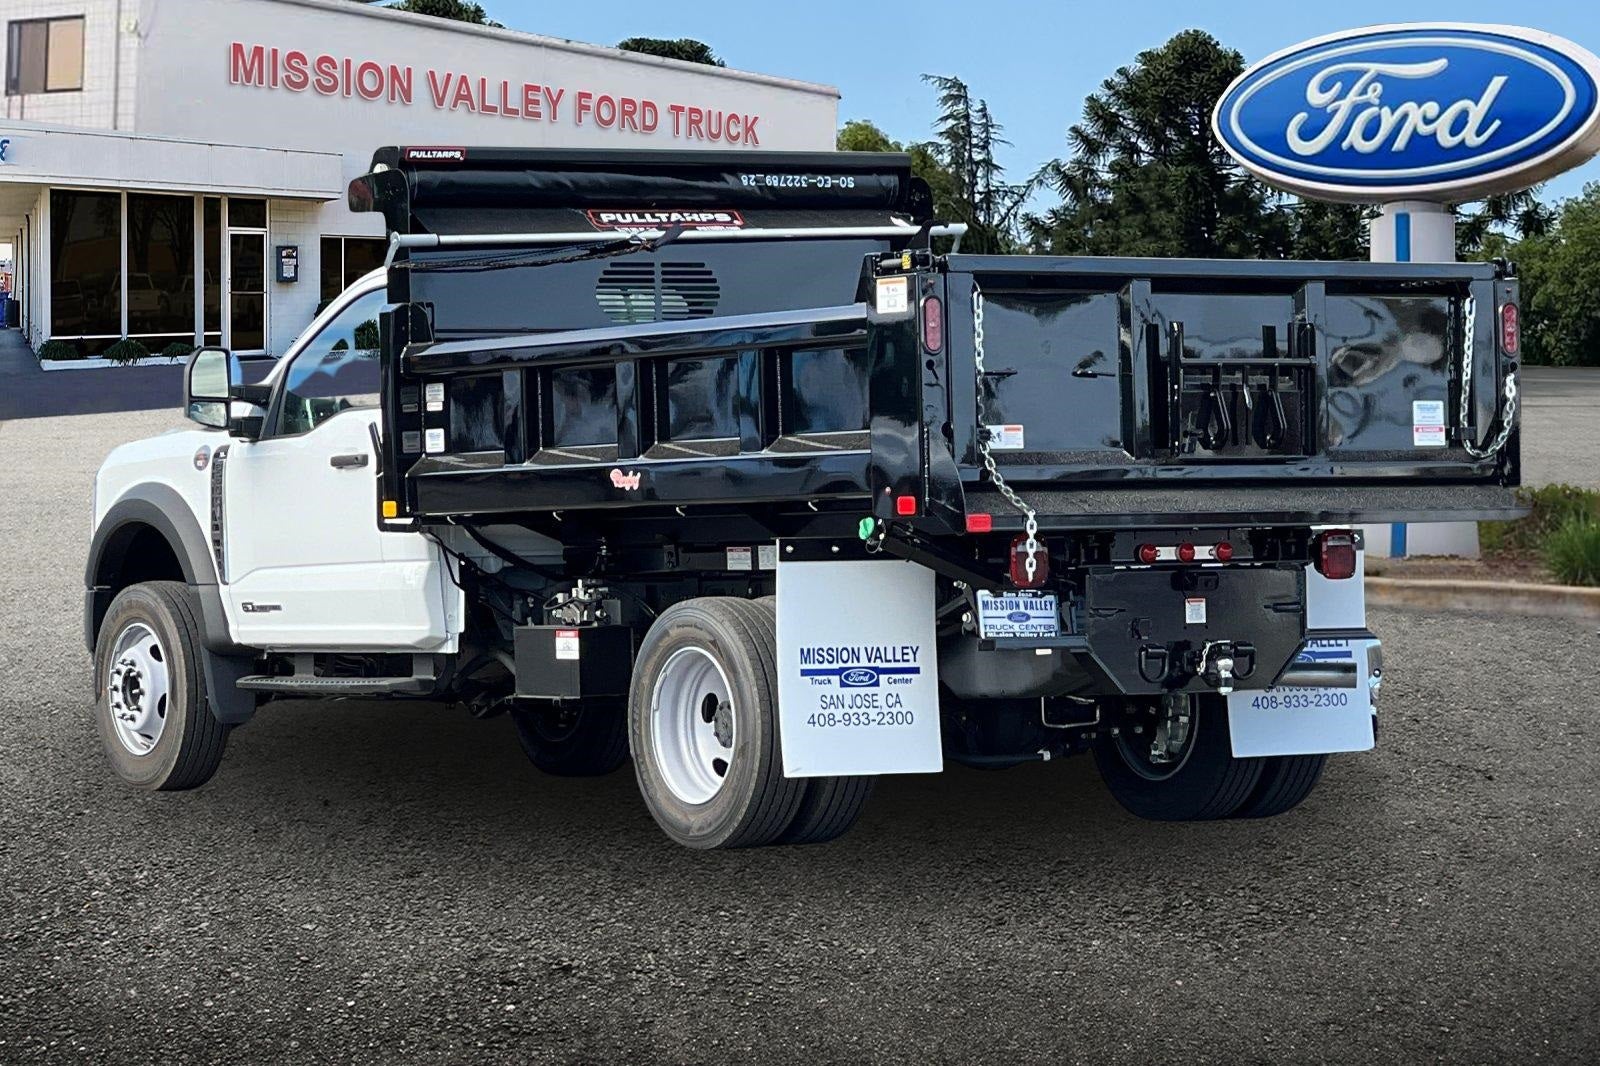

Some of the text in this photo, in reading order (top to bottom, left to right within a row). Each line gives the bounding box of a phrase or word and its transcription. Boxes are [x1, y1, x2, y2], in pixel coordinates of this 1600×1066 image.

[229, 41, 761, 146] MISSION VALLEY FORD TRUCK
[1286, 57, 1508, 156] Ford
[409, 150, 461, 158] PULLTARPS
[982, 600, 1054, 610] MISSION VALLEY
[800, 646, 919, 665] MISSION VALLEY
[810, 671, 913, 685] Truck Ford Center
[820, 693, 903, 710] SAN JOSE, CA
[1251, 692, 1348, 711] 408-933-2300
[807, 711, 914, 728] 408-933-2300
